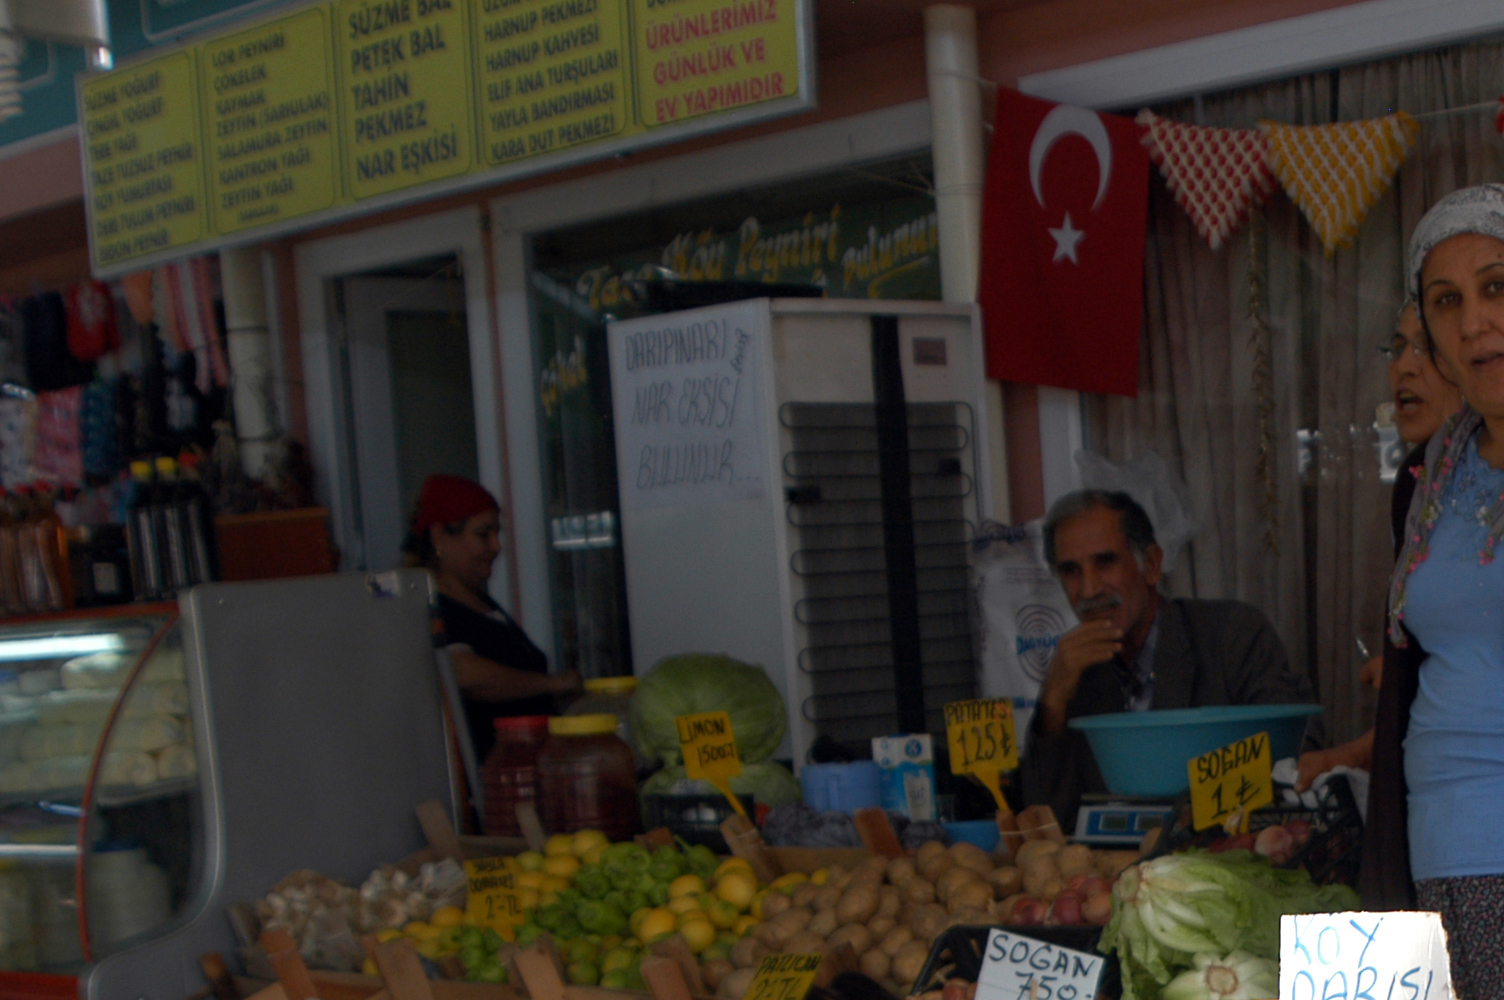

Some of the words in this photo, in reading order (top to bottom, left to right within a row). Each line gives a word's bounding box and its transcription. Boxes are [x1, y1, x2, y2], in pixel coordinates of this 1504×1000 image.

[351, 34, 404, 74] PETEK
[409, 23, 445, 57] BAL
[484, 11, 538, 42] HARNUP
[486, 41, 540, 72] HARNUP
[516, 70, 544, 95] ANA
[547, 48, 618, 86] TURŞULARI
[653, 43, 735, 86] GÜNLÜK
[740, 37, 767, 63] VE
[351, 67, 411, 111] TAHİN
[490, 105, 528, 132] YAYLA
[531, 81, 615, 121] BANDIRMASI
[656, 98, 678, 122] EV
[683, 71, 784, 114] YAPIMIDIR
[354, 101, 427, 143] PEKMEZ
[492, 137, 525, 161] KARA
[529, 129, 554, 152] DUT
[558, 107, 616, 144] PEKMEZİ
[357, 148, 396, 182] NAR
[631, 380, 672, 426] NAR
[988, 934, 1096, 978] SOGAN
